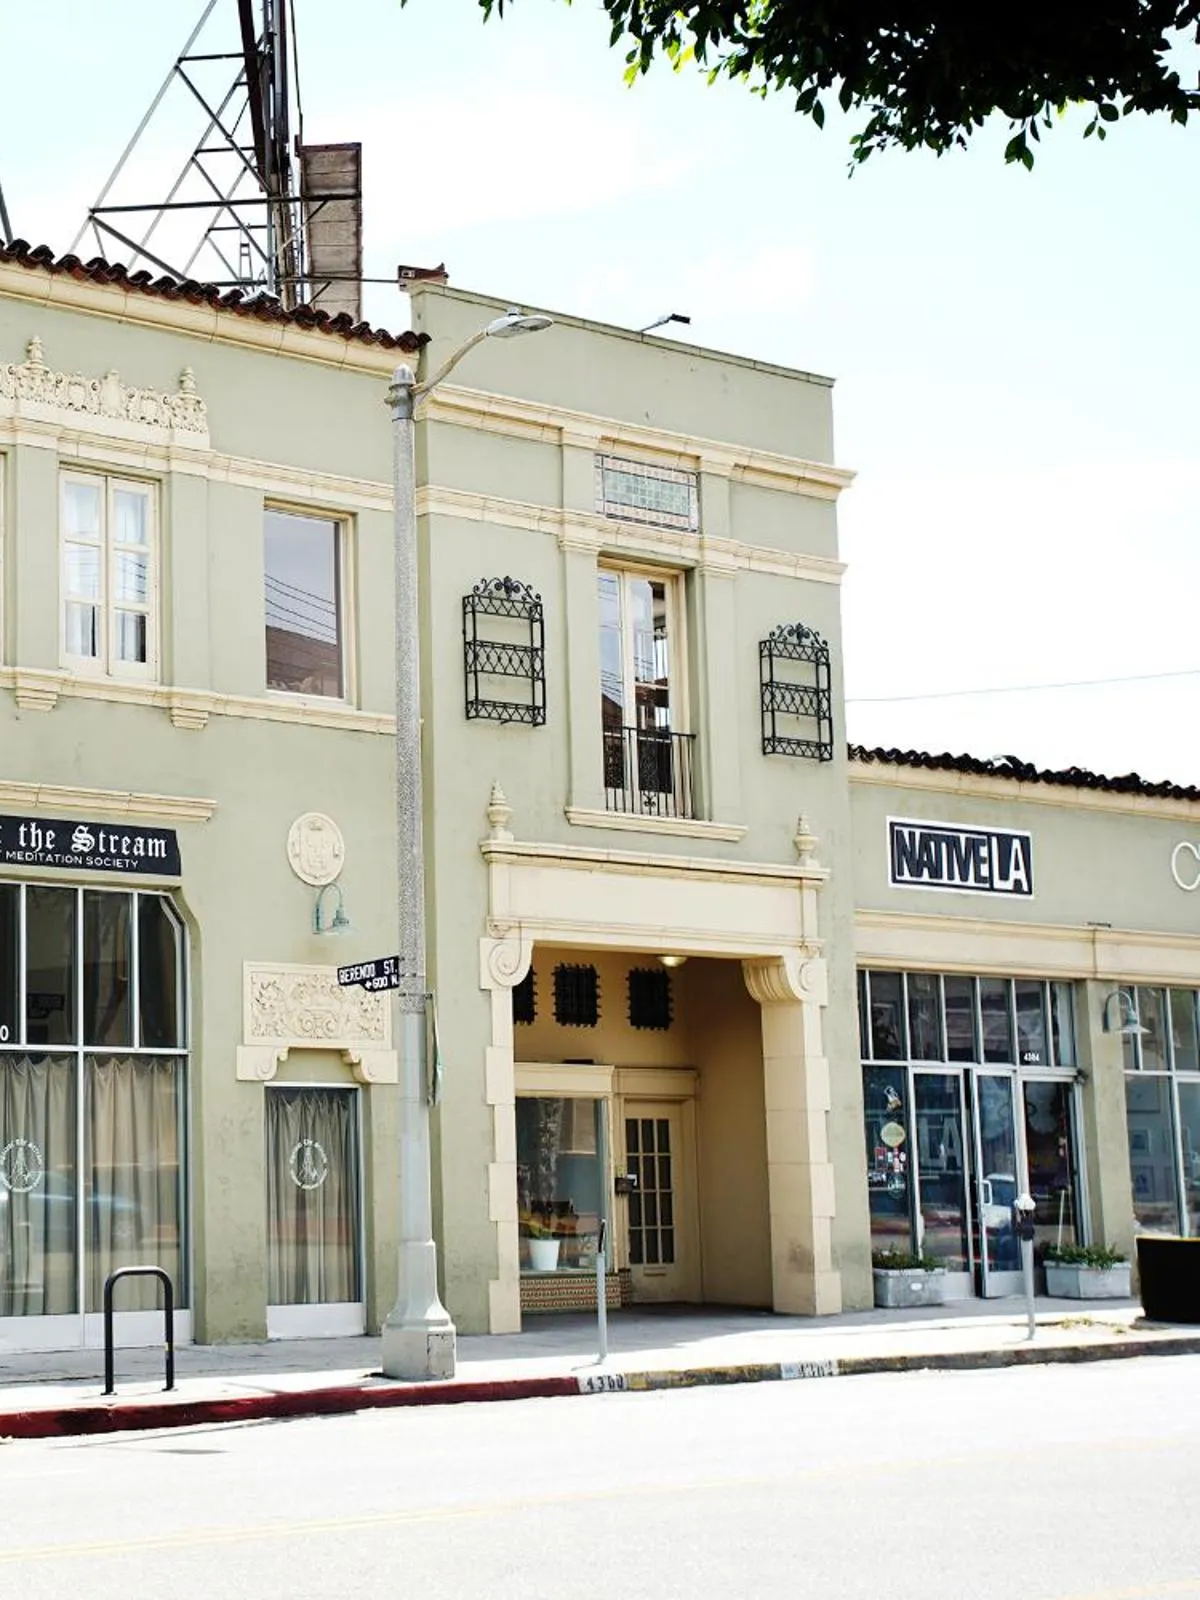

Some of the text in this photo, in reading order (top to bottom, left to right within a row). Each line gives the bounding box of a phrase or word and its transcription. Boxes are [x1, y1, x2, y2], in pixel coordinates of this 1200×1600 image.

[18, 822, 56, 853] the
[71, 825, 168, 859] Stream
[5, 850, 83, 865] MEDITATION
[85, 856, 140, 869] SOCIETY
[895, 829, 1030, 892] NATIVE LA
[383, 959, 398, 975] ST.
[586, 1374, 624, 1391] 4300
